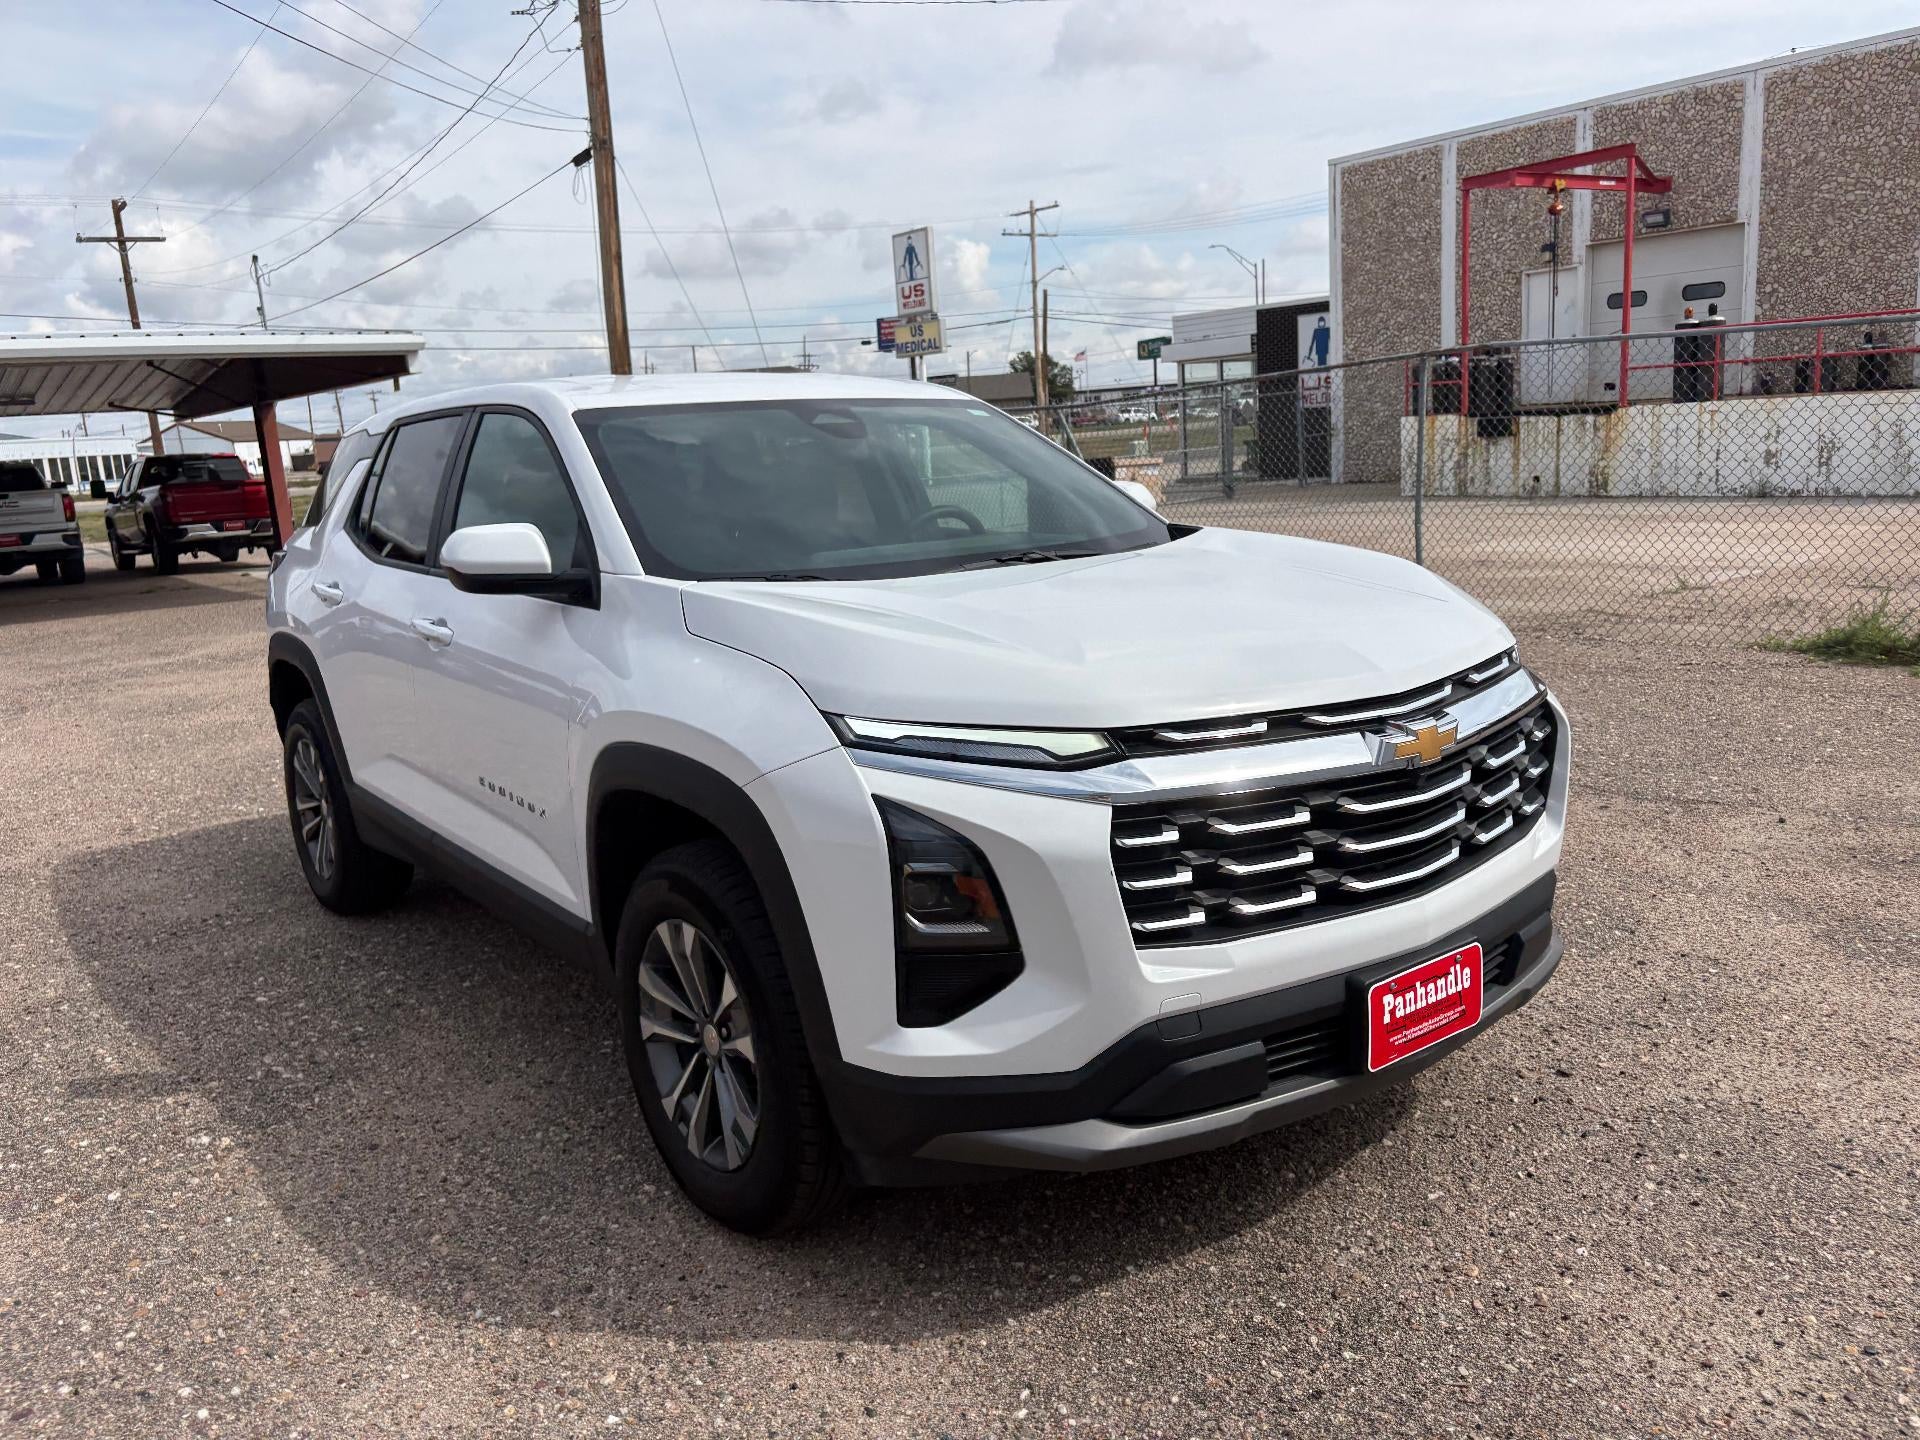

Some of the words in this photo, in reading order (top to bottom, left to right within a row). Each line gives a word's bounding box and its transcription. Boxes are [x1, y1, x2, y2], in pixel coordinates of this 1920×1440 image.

[901, 283, 925, 299] US
[910, 325, 924, 337] US
[896, 339, 940, 353] MEDICAL
[479, 776, 547, 819] EQUINOX
[1382, 963, 1471, 1024] Panhandle
